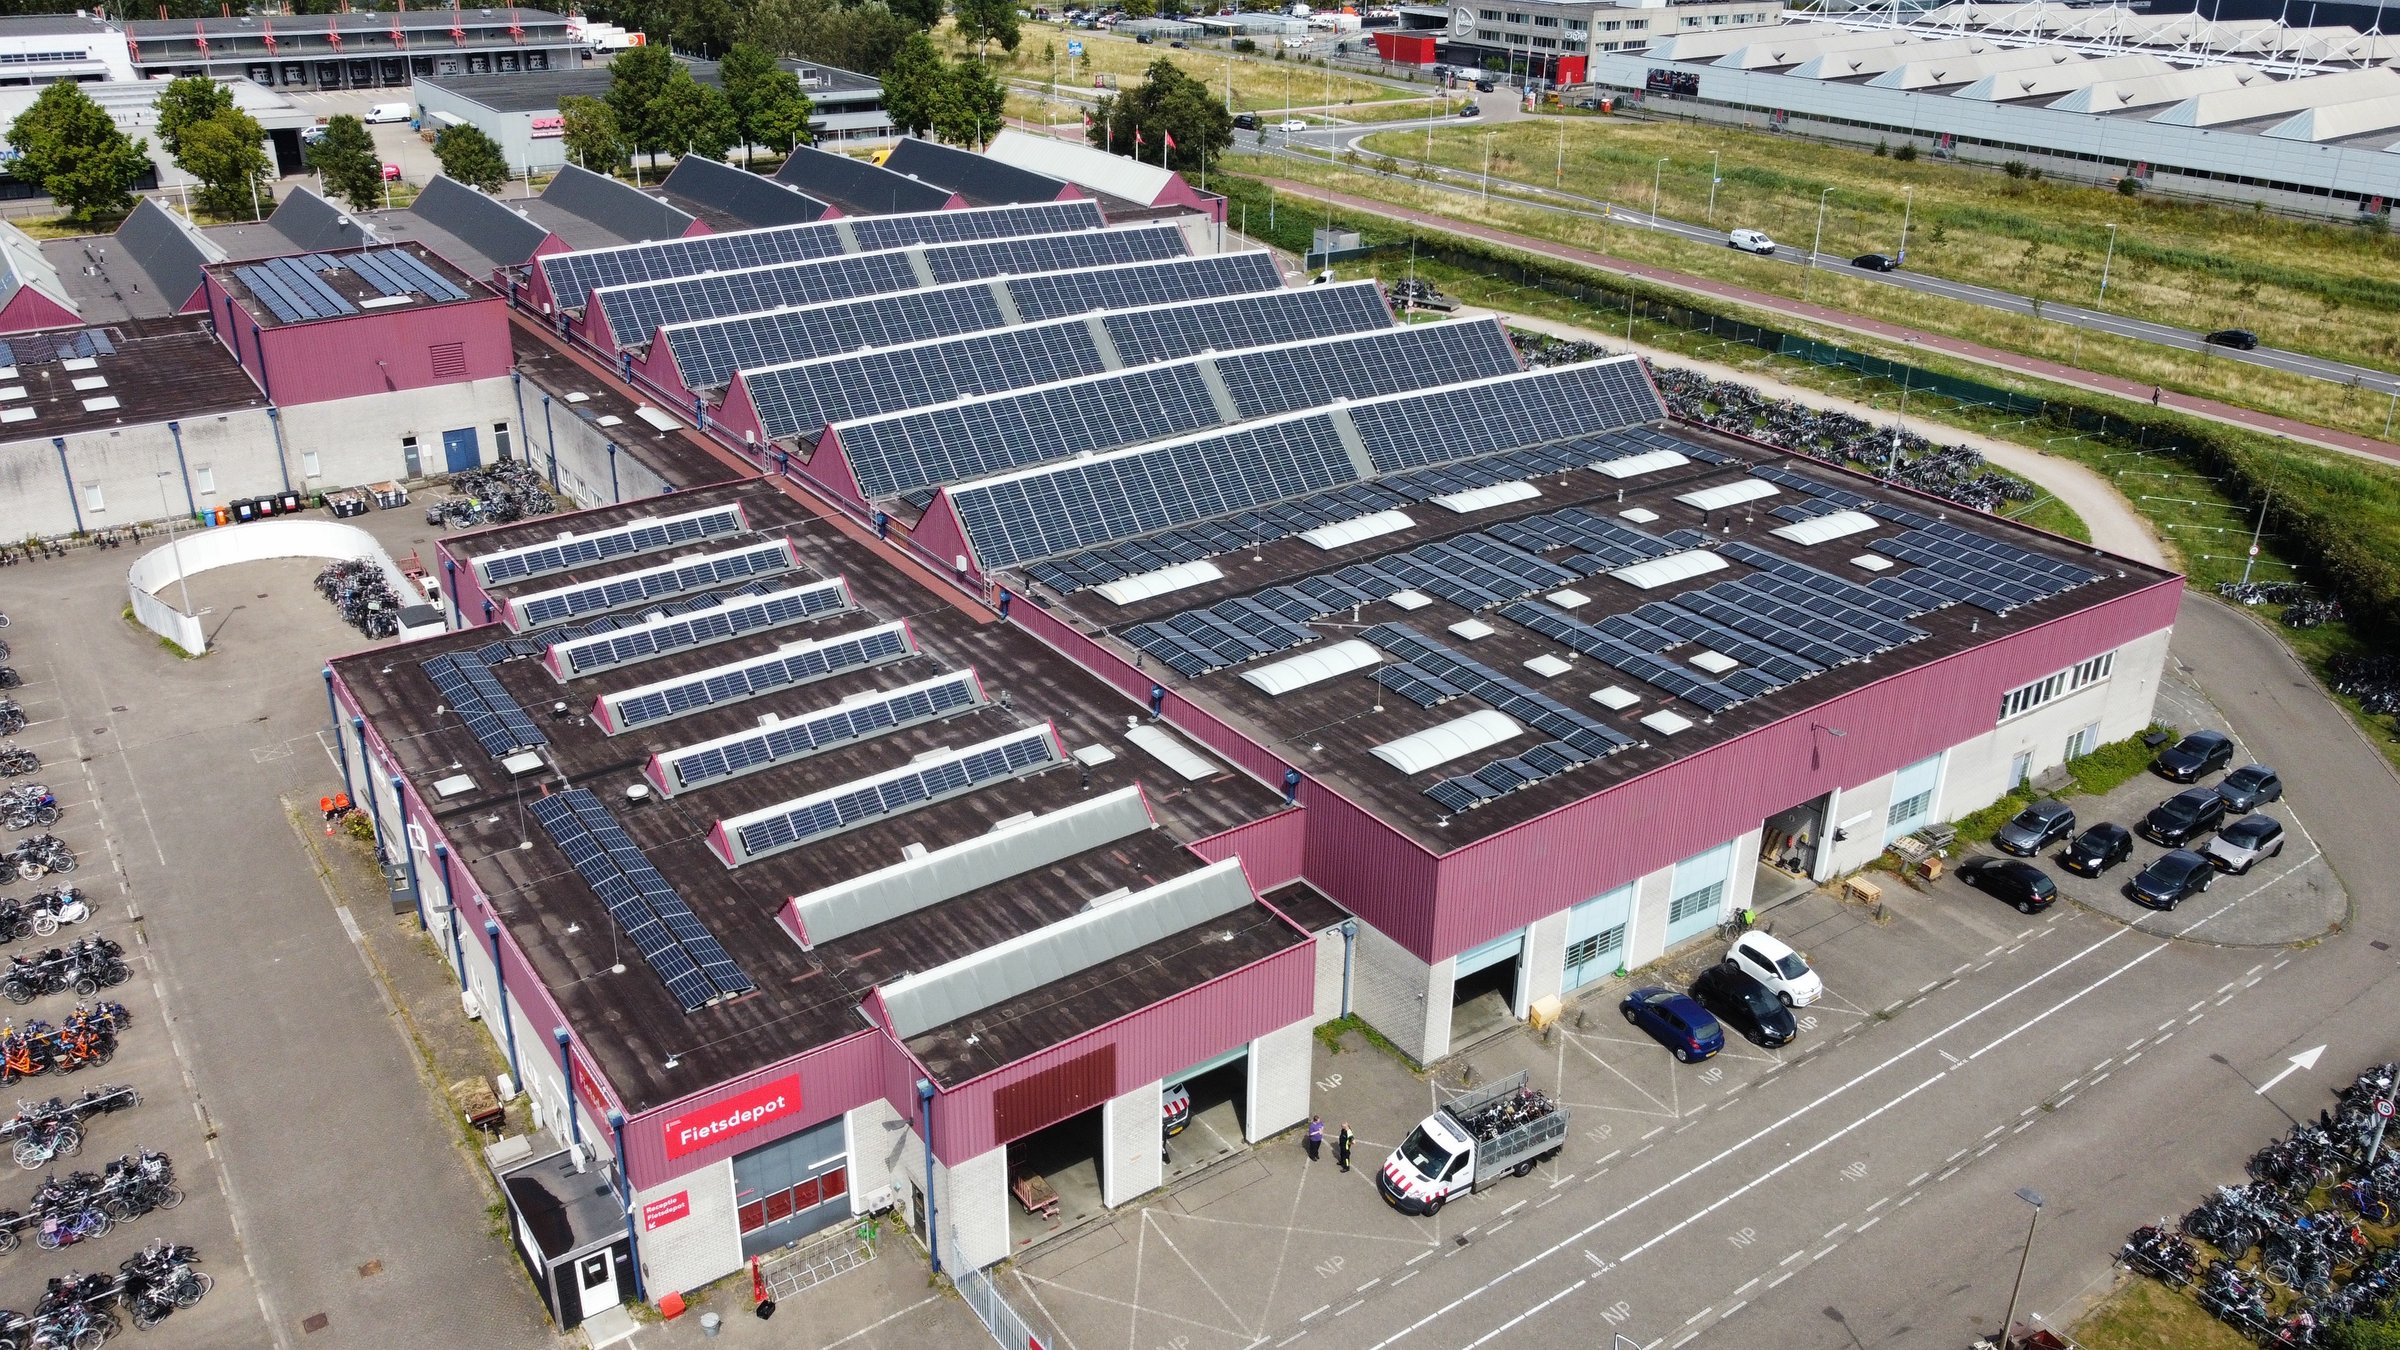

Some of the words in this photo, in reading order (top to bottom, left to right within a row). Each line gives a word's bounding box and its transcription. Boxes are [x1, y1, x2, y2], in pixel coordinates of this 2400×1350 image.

[1797, 1016, 1818, 1032] NP
[1316, 1073, 1342, 1091] NP
[1698, 1067, 1723, 1086] NP
[680, 1095, 786, 1146] Fietsdepot
[1585, 1124, 1612, 1143] NP
[1840, 1161, 1868, 1181] NP
[646, 1198, 677, 1213] Receptie
[647, 1202, 686, 1221] Fietsdepot
[1728, 1227, 1756, 1249] NP
[1314, 1255, 1345, 1279] NP
[1600, 1301, 1630, 1326] NP
